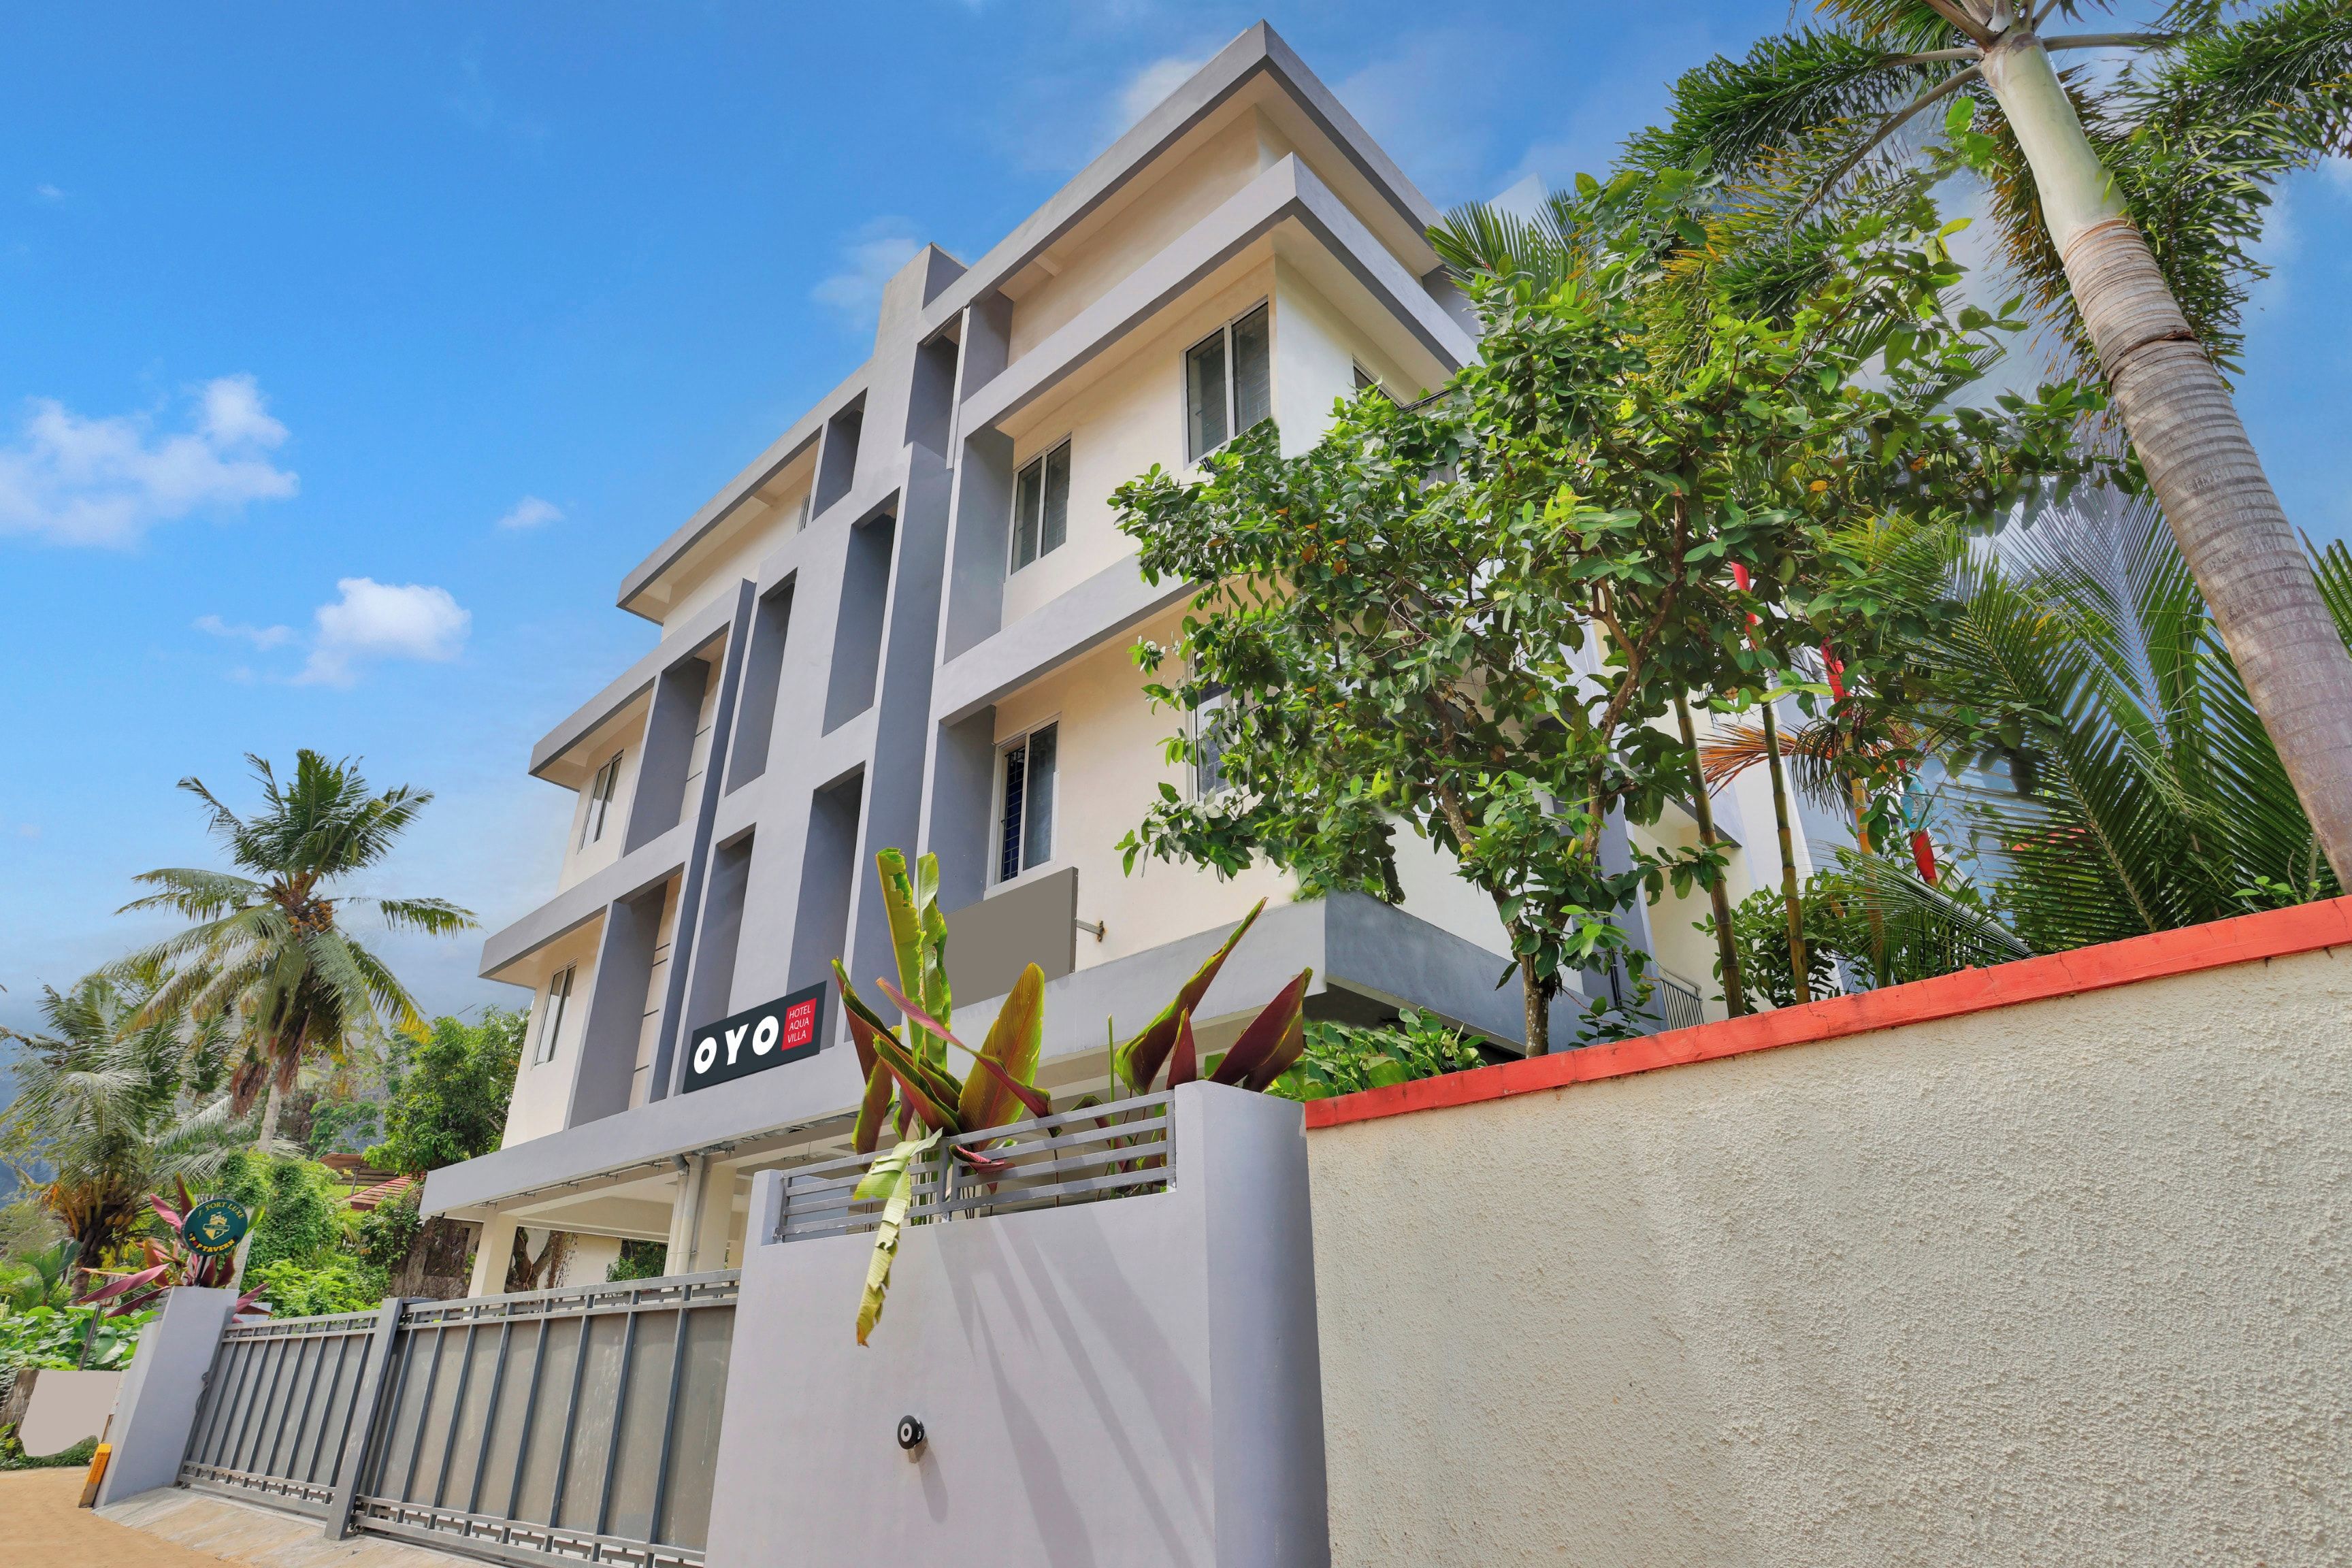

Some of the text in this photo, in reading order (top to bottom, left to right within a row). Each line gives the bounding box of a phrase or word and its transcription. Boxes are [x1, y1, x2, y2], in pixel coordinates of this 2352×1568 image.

[789, 1004, 811, 1019] HOTEL
[789, 1017, 809, 1032] AQUA
[787, 1030, 806, 1043] VILLA
[693, 1015, 779, 1074] OYO
[206, 1201, 227, 1211] FORT
[227, 1203, 244, 1220] LUXE
[202, 1239, 235, 1252] TAVERN
